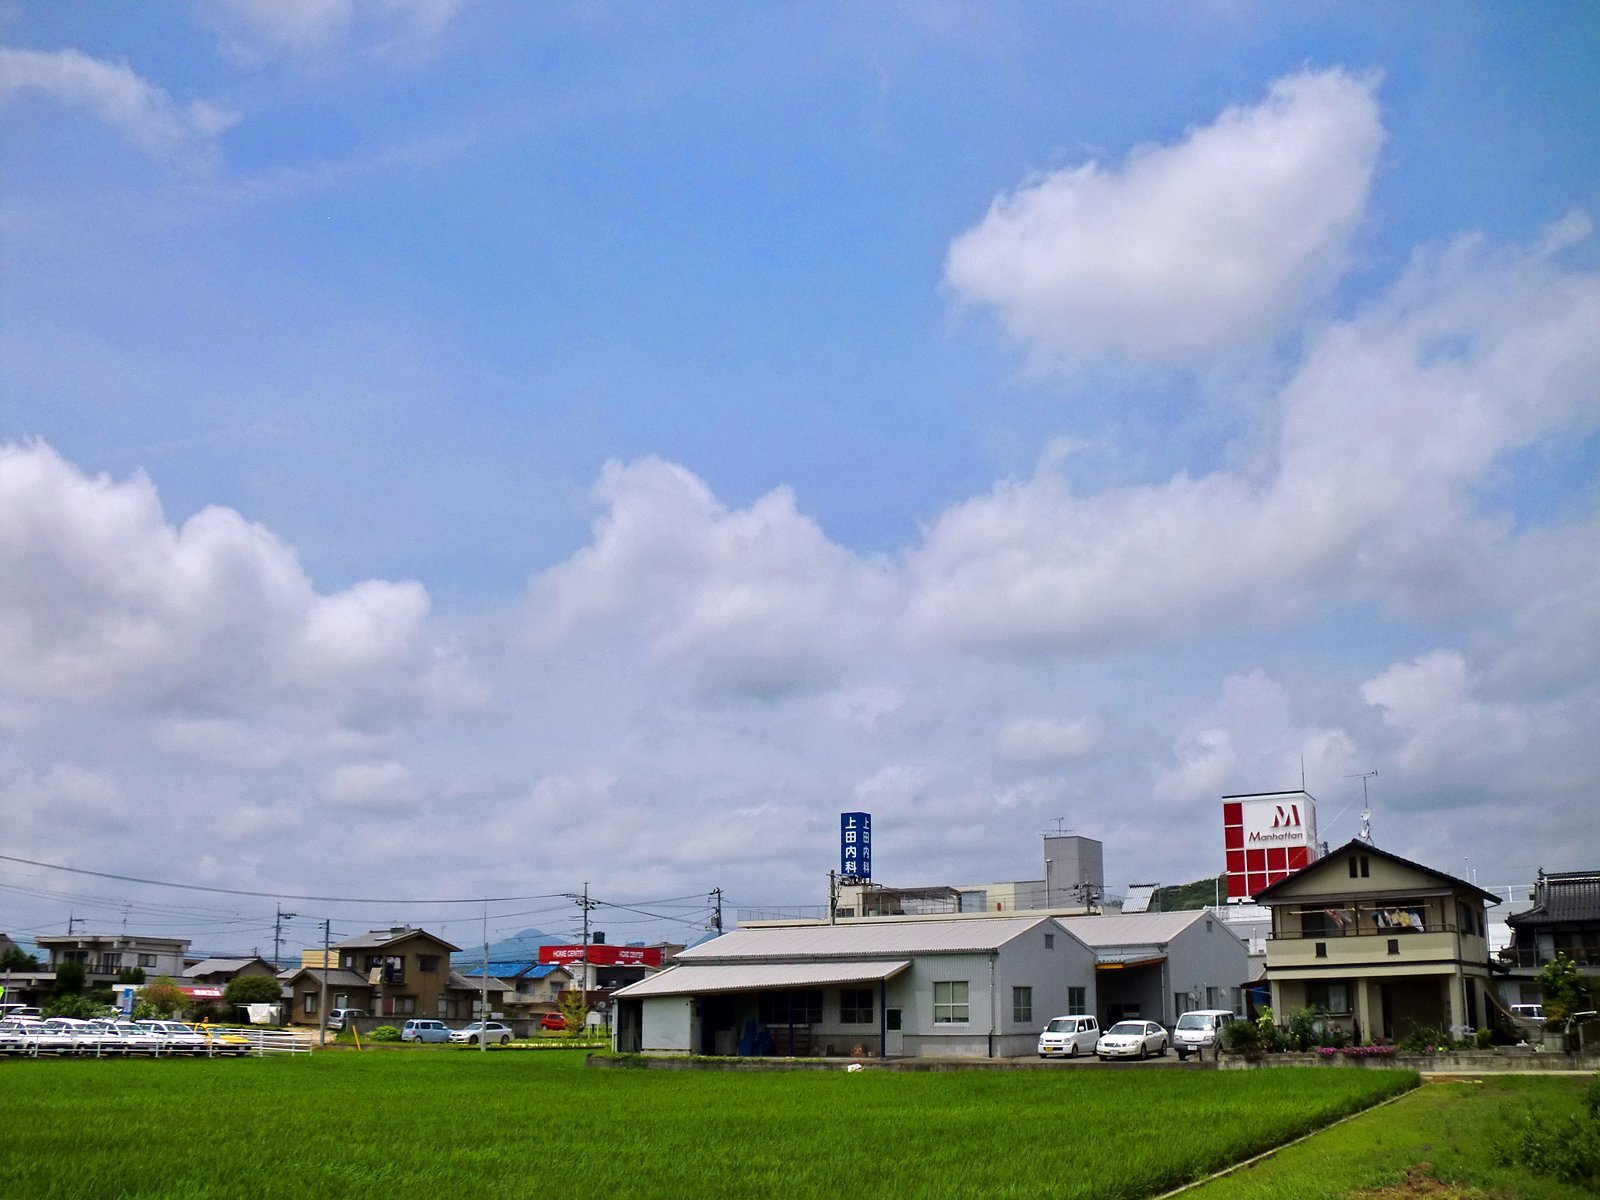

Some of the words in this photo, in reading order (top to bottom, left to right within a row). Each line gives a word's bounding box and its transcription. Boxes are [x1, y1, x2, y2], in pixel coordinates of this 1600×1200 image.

[845, 816, 857, 873] 上田内科
[1249, 832, 1303, 842] Manhattan
